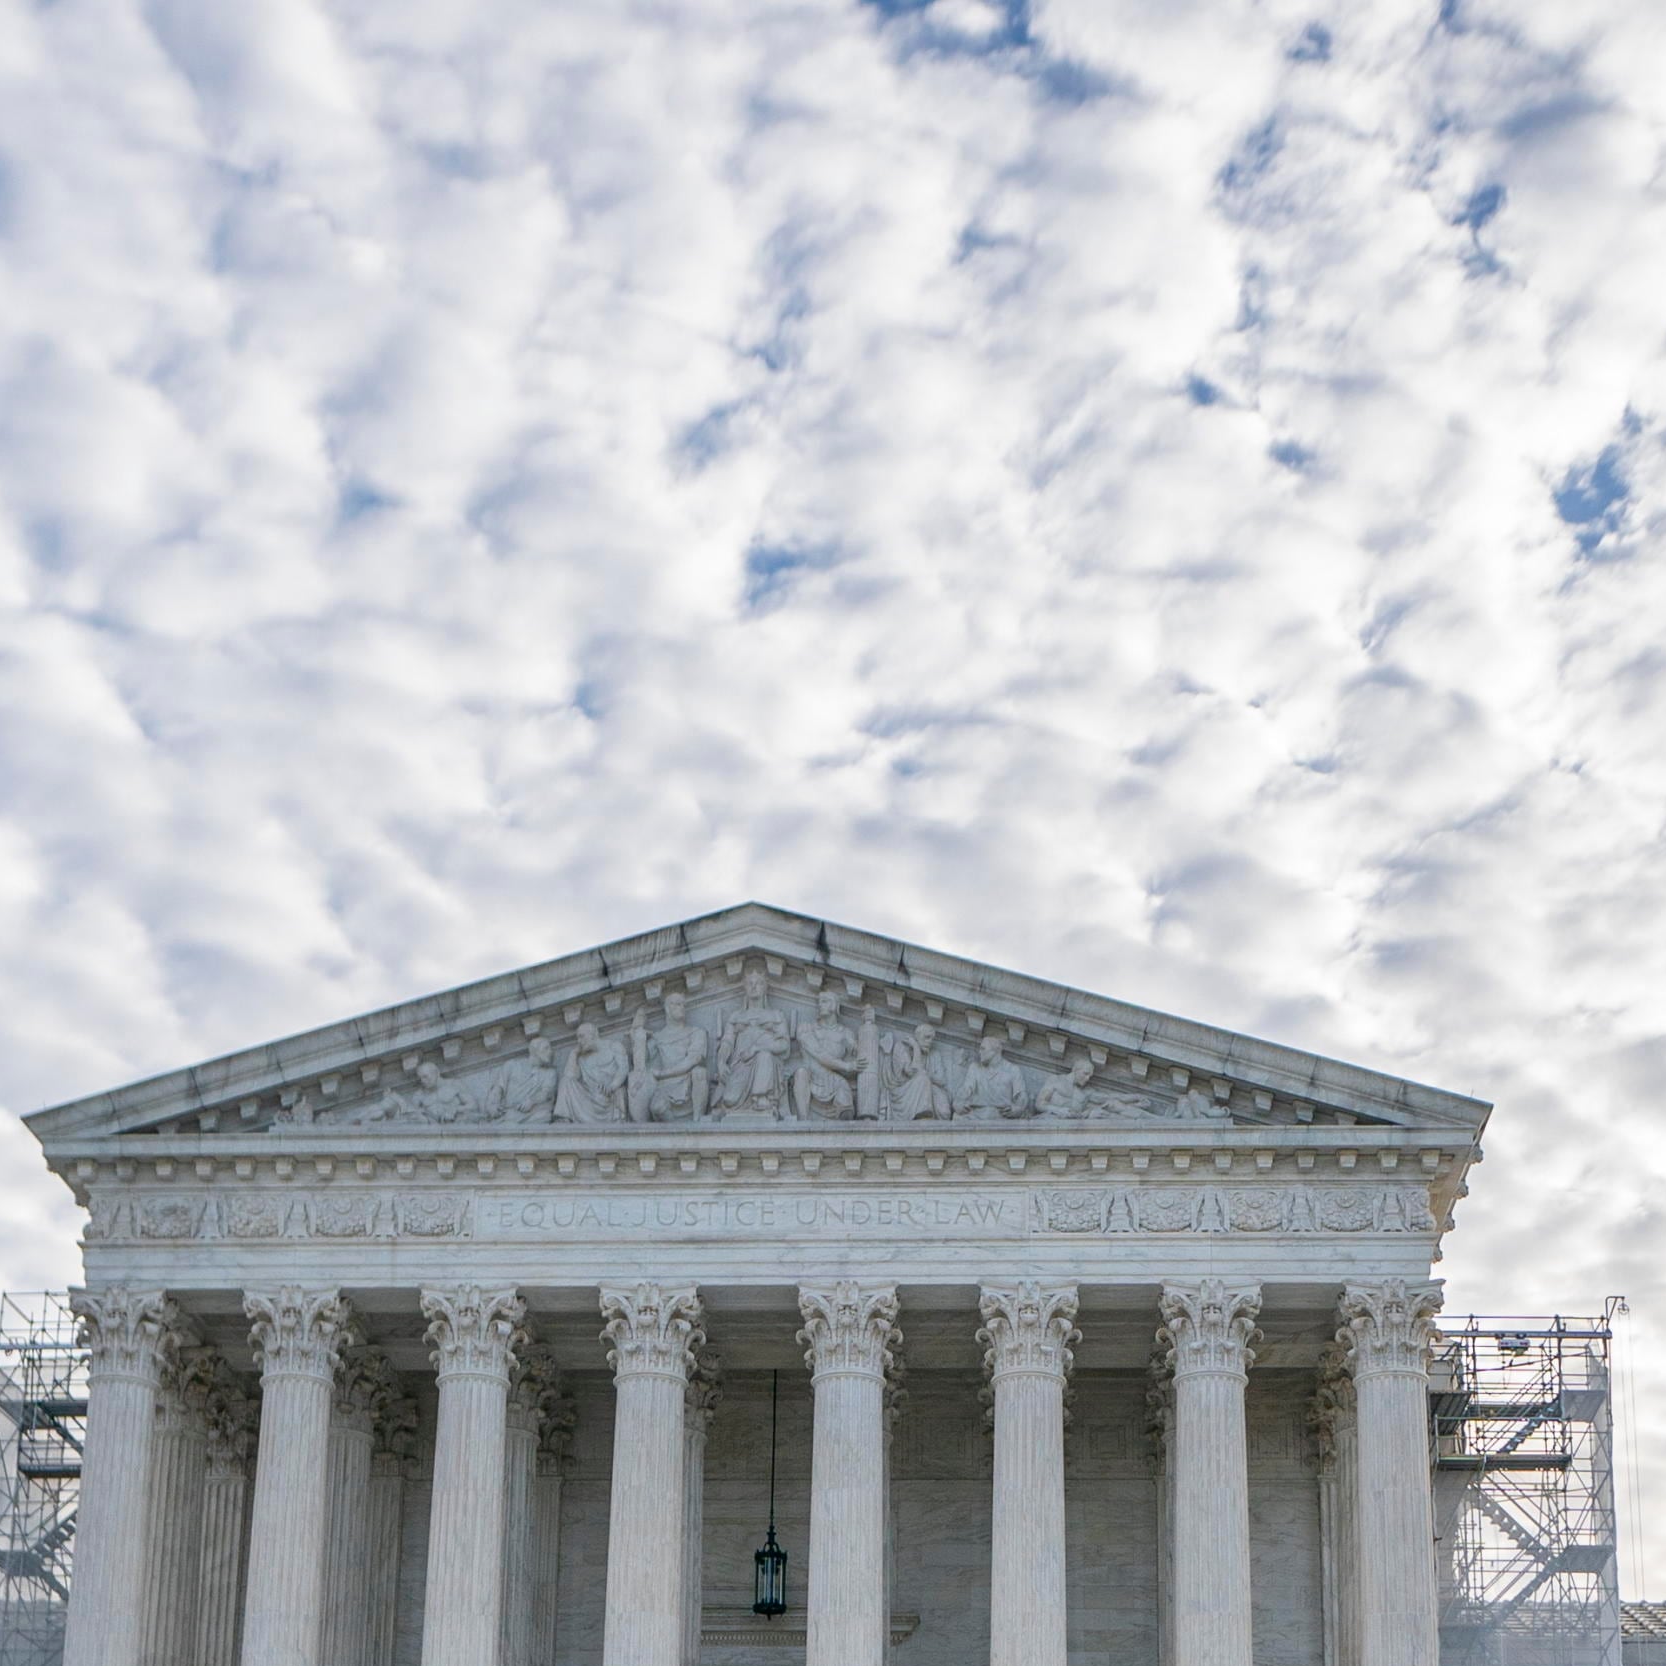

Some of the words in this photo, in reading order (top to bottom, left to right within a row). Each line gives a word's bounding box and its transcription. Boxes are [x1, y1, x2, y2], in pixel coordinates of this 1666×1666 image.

[498, 1201, 624, 1229] EQUAL
[630, 1200, 776, 1228] JUSTICE
[795, 1199, 919, 1226] UNDER
[933, 1199, 1006, 1225] LAW
